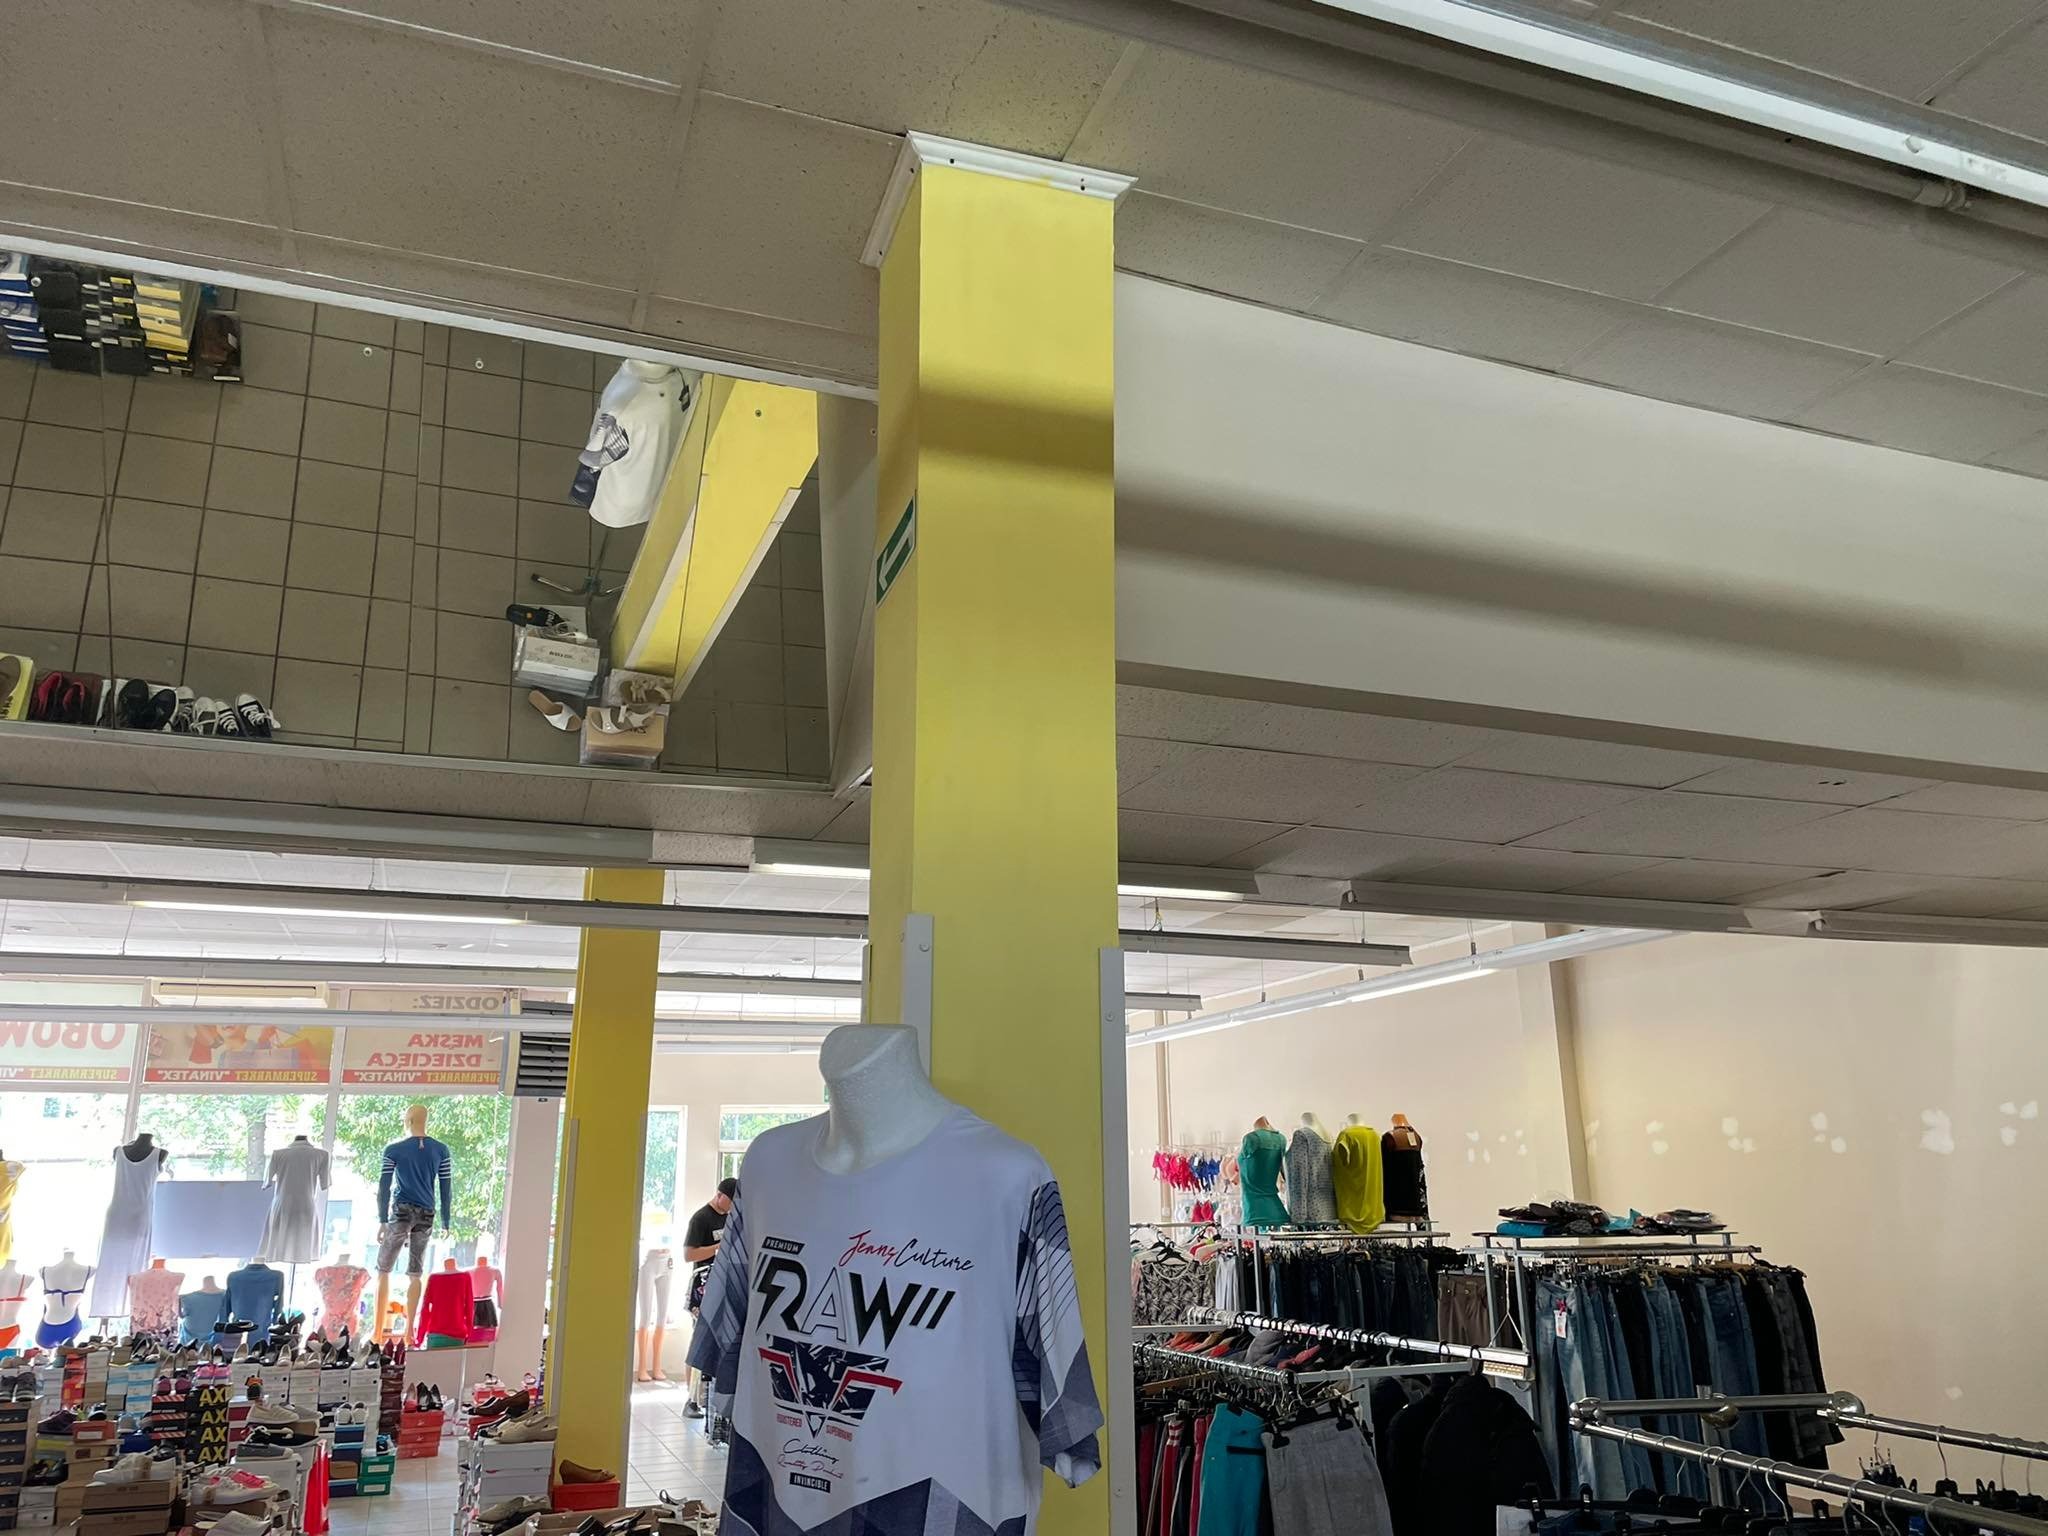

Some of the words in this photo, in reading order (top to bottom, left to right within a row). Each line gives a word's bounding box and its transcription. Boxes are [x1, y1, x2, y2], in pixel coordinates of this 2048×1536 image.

[764, 1238, 800, 1253] PREMIUM
[893, 1238, 975, 1271] Culture
[793, 1474, 829, 1491] INVINCIBLE
